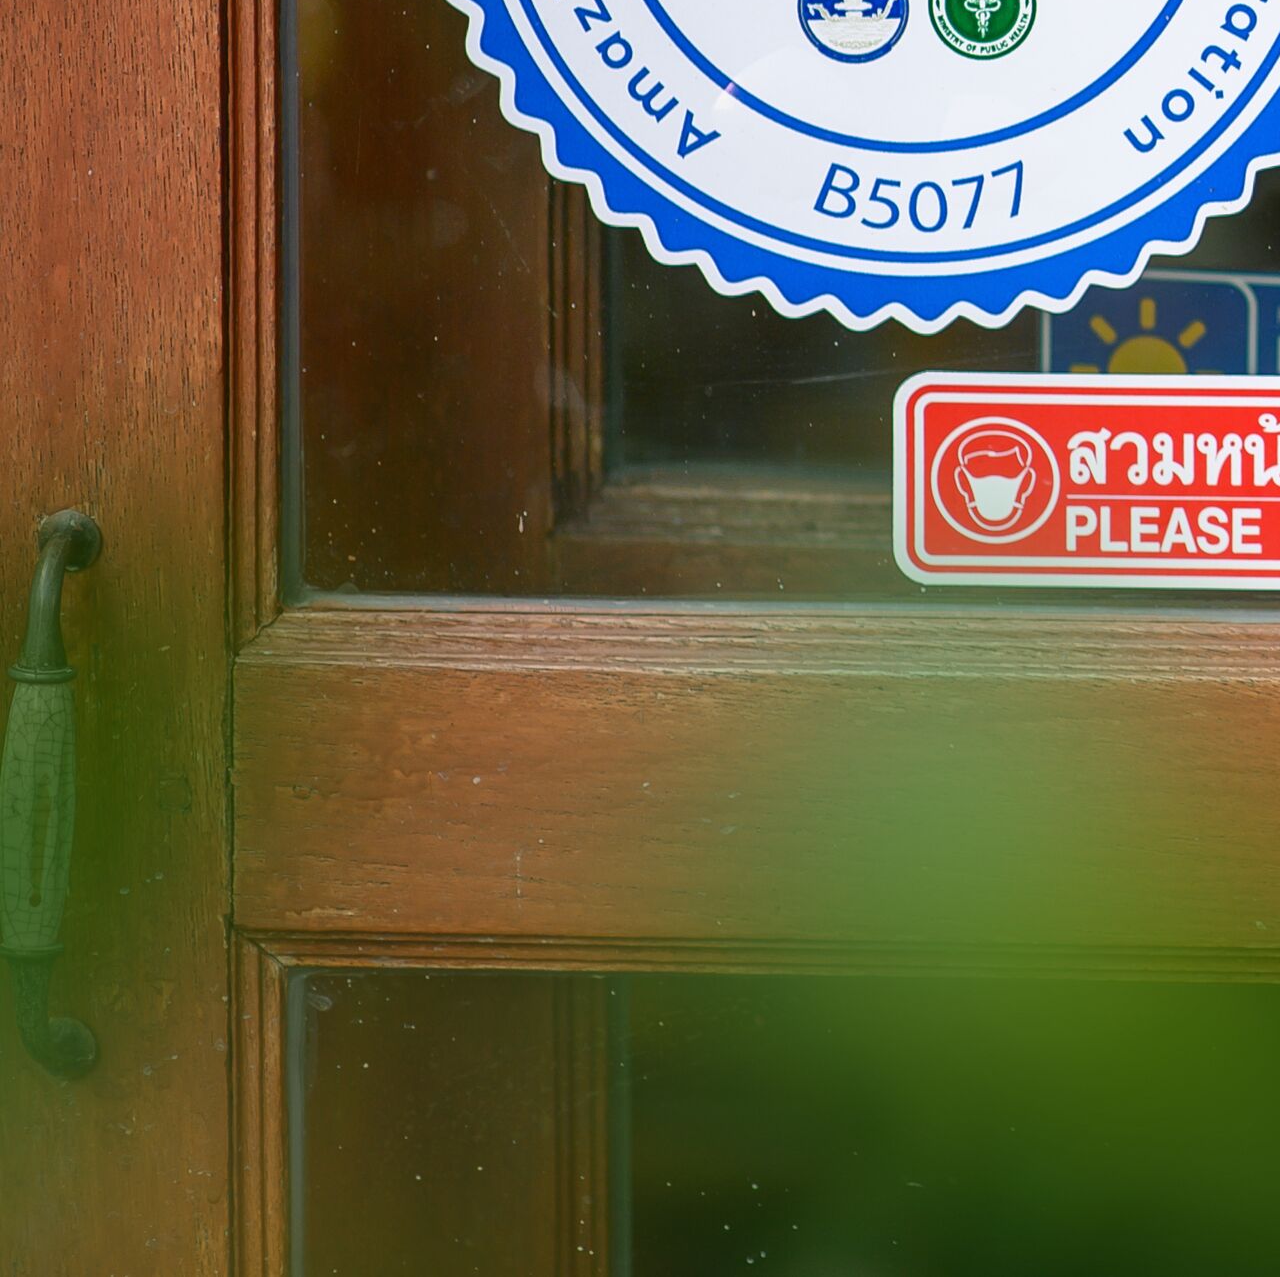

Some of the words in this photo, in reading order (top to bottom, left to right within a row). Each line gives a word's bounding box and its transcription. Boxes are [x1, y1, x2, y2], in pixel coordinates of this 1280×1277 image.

[966, 44, 977, 53] OF
[980, 40, 1009, 54] PUBLIC
[1009, 13, 1030, 42] HEALTH
[813, 160, 1024, 233] B5077
[1066, 506, 1263, 557] PLEASE
